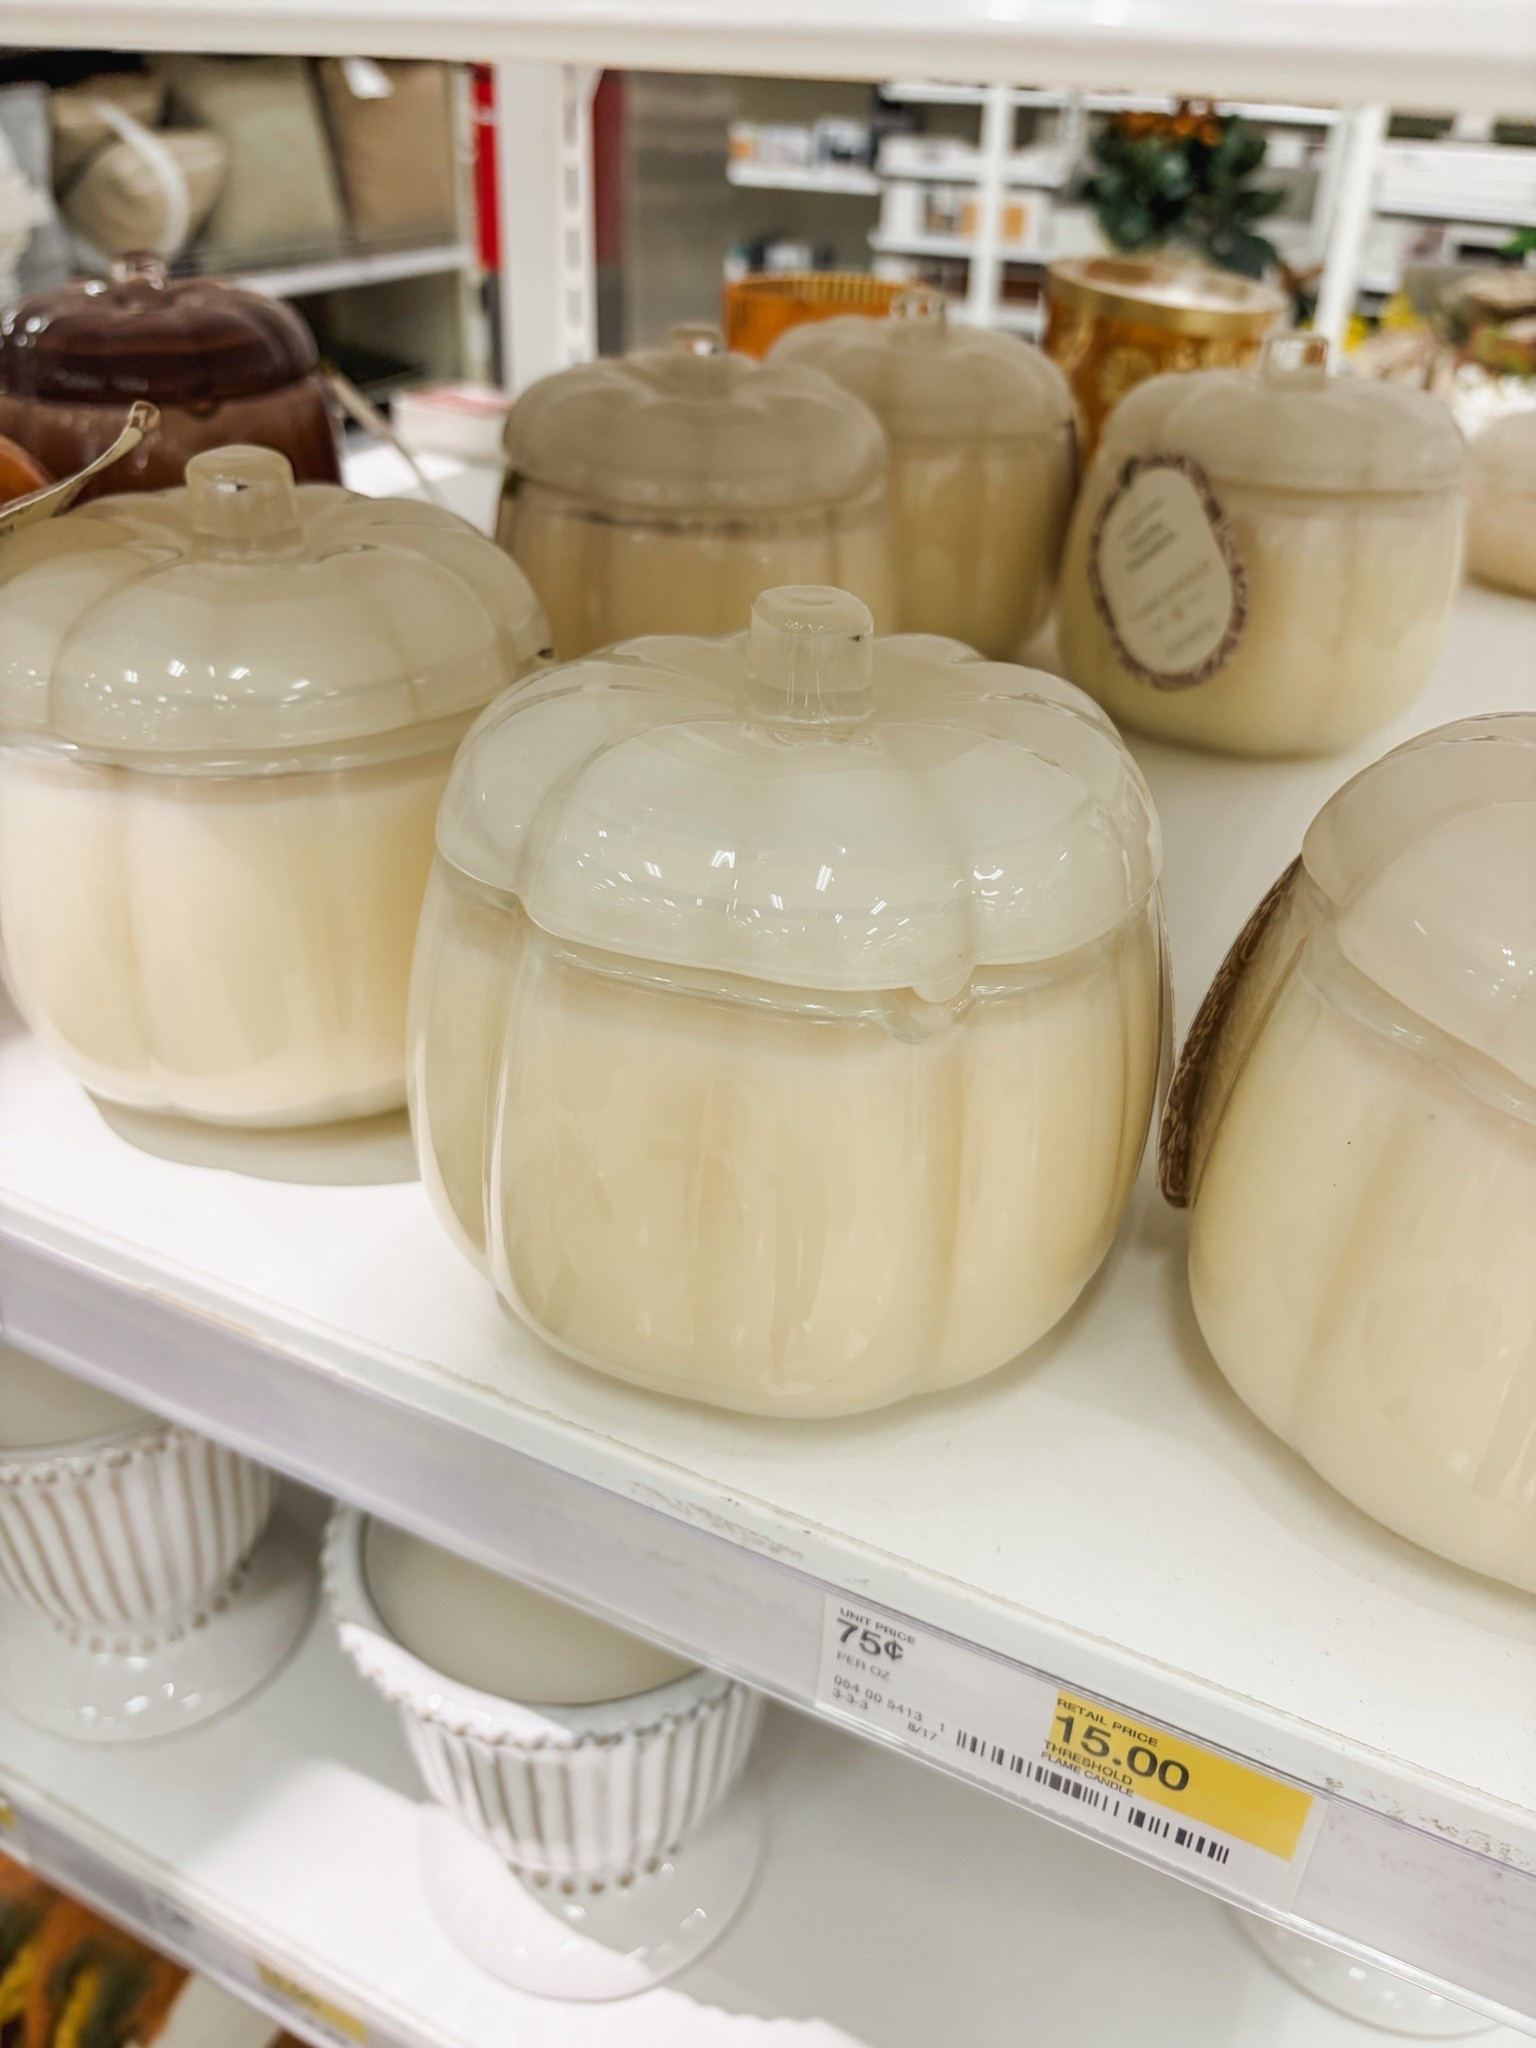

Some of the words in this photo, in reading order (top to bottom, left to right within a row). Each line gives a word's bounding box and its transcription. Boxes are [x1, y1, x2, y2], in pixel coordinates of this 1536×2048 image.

[837, 1617, 904, 1661] 75¢
[840, 1606, 871, 1626] UNIT
[875, 1621, 916, 1646] PRICE
[837, 1650, 866, 1671] PER
[870, 1665, 890, 1681] OZ
[1057, 1698, 1107, 1726] RETAIL
[1112, 1721, 1159, 1747] PRICE
[1041, 1751, 1081, 1774] FLAME
[1084, 1769, 1134, 1798] CANDLE
[1044, 1740, 1133, 1786] THRESHOLD
[1056, 1714, 1189, 1791] 15.00
